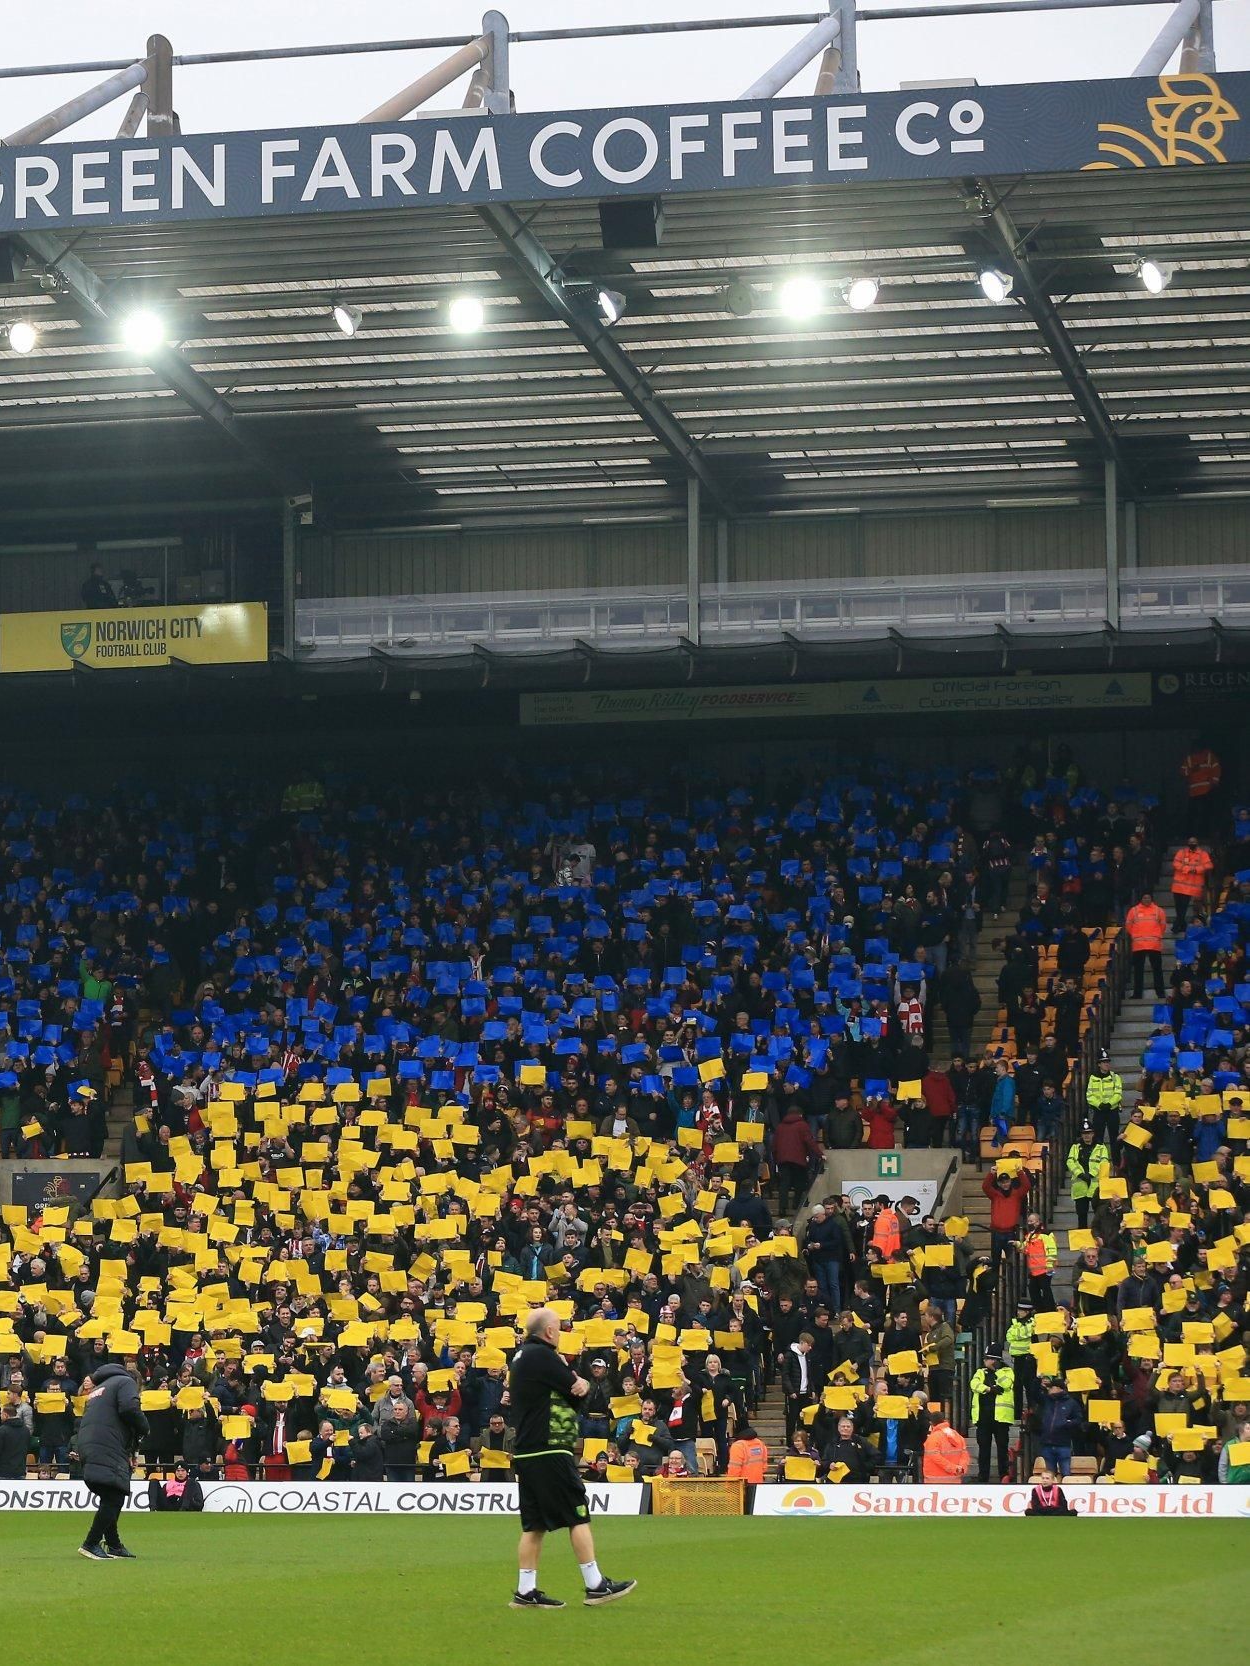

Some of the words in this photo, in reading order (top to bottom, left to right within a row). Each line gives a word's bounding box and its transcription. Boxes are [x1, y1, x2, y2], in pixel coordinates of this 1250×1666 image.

[261, 126, 503, 204] FARM
[529, 104, 868, 188] COFFEE
[95, 619, 166, 642] NORWICH
[170, 617, 204, 639] CITY
[95, 643, 142, 658] FOOTBALL
[143, 641, 167, 656] CLUB
[932, 679, 990, 693] Official
[994, 679, 1062, 693] Foreign
[590, 694, 646, 711] Thomas
[647, 690, 701, 717] Ridley
[700, 691, 797, 705] FOODSERVICE
[918, 696, 1001, 710] Currency
[1005, 694, 1075, 708] Supplier
[881, 1156, 898, 1174] H
[258, 1490, 390, 1512] COASTAL
[396, 1491, 610, 1513] CONSTRUN
[851, 1490, 993, 1514] Sanders
[1000, 1491, 1147, 1514] Cches
[1155, 1491, 1214, 1514] Ltd
